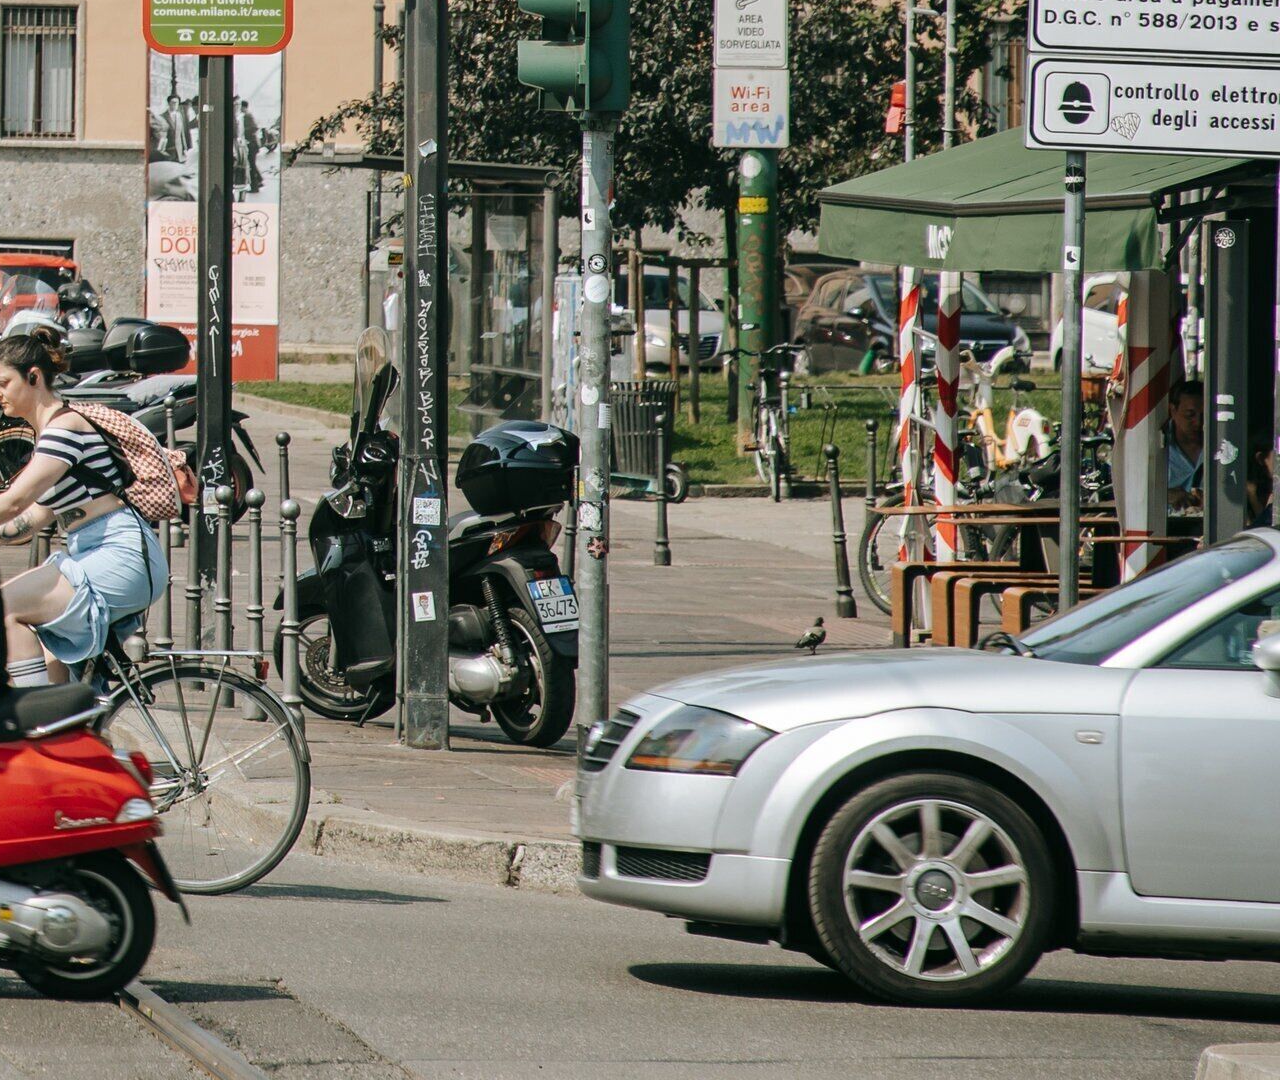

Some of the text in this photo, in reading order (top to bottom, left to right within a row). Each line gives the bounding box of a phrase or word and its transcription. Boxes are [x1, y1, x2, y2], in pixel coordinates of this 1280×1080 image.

[153, 7, 281, 18] comune.milano.it/areac
[738, 15, 763, 24] AREA
[1044, 9, 1102, 25] D.G.C.
[1139, 12, 1238, 30] 588/2013
[1247, 19, 1259, 31] e
[199, 31, 259, 42] 02.02.02
[737, 27, 765, 37] VIDEO
[720, 39, 782, 49] SORVEGLIATA
[730, 86, 771, 99] Wi-Fi
[1114, 83, 1200, 101] controllo
[730, 101, 770, 113] area
[1152, 108, 1198, 130] degli
[1210, 113, 1275, 131] accessi
[160, 226, 198, 237] ROBER
[538, 581, 557, 598] EK
[537, 599, 578, 619] 36473
